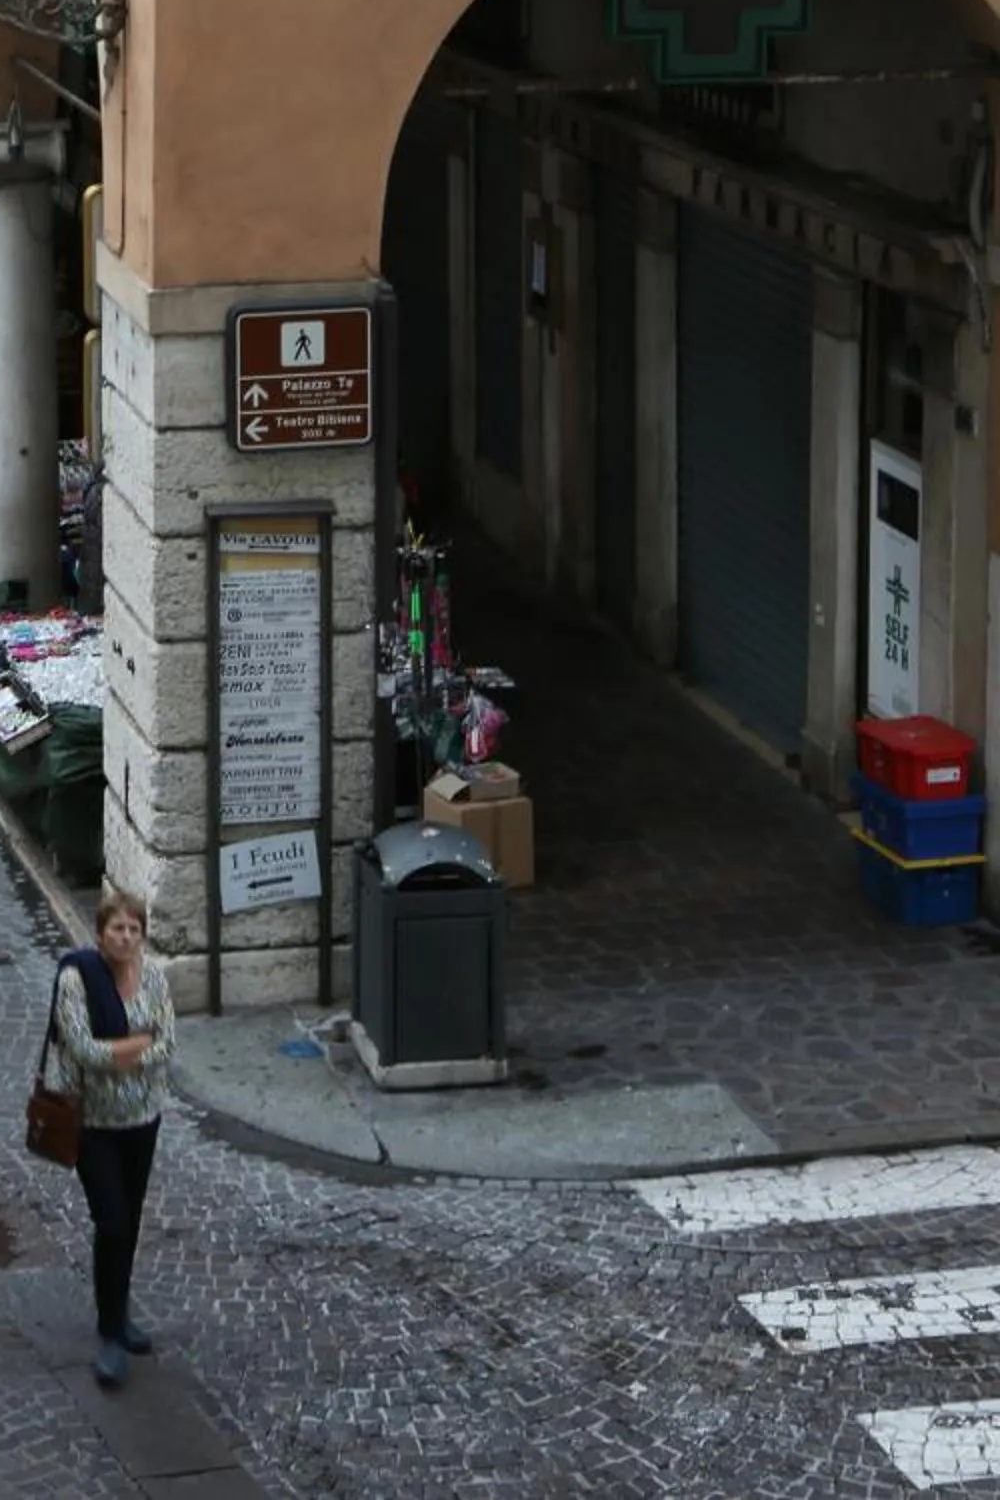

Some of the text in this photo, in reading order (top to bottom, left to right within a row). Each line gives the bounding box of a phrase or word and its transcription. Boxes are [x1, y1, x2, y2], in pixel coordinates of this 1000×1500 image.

[282, 376, 354, 392] Palazzo Te
[276, 416, 314, 429] Teatro
